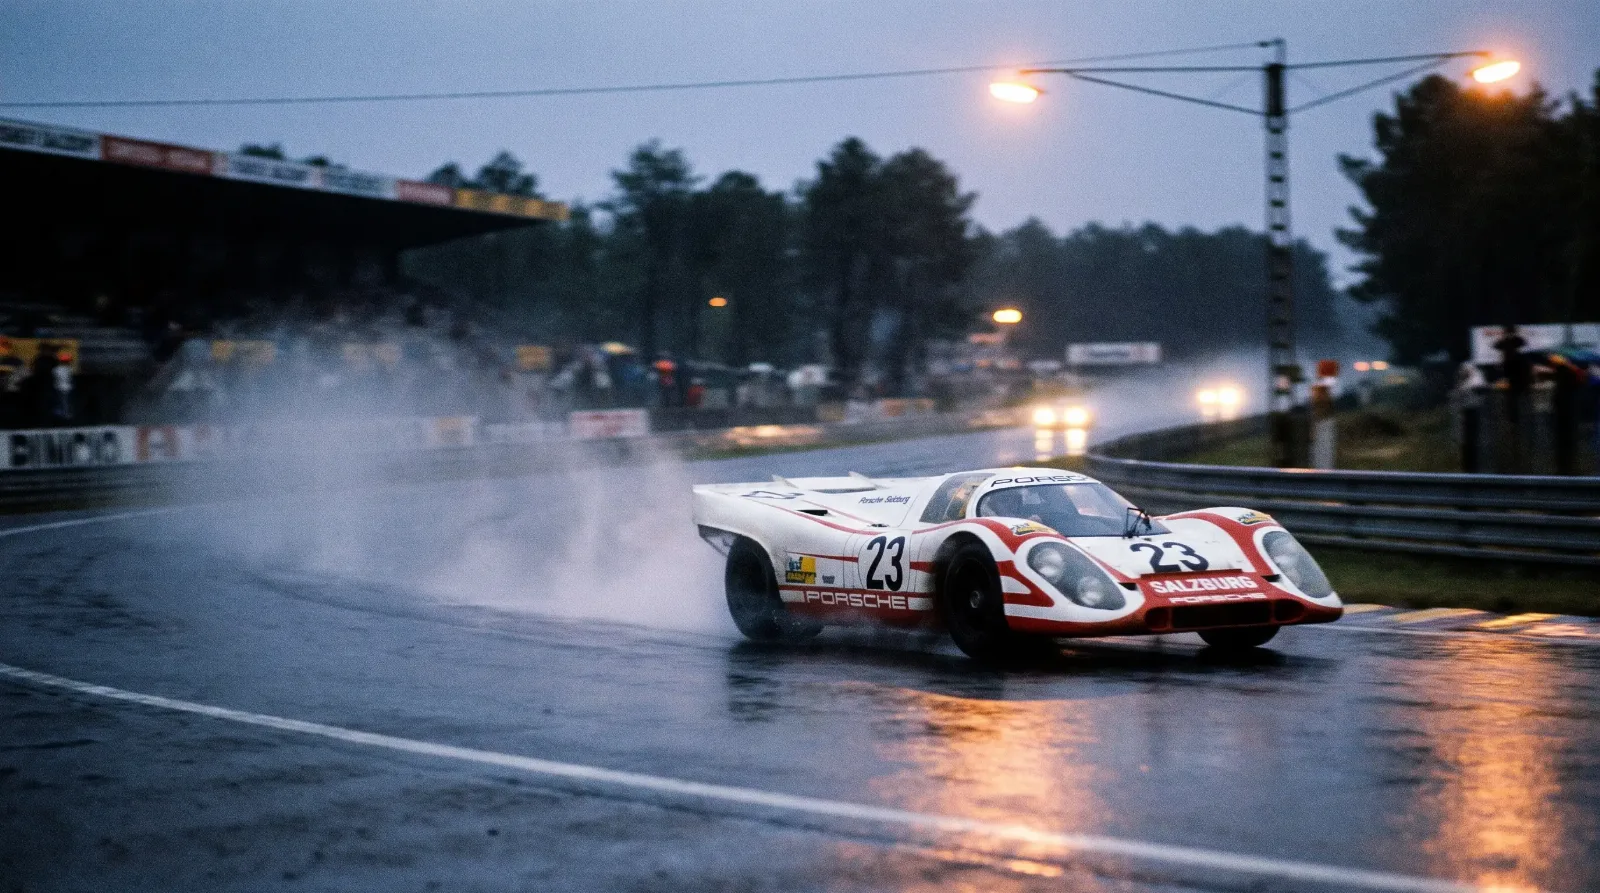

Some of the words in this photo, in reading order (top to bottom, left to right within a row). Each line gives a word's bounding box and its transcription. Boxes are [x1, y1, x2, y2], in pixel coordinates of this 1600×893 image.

[866, 535, 906, 591] 23
[1130, 541, 1209, 573] 23
[1150, 575, 1258, 594] SALZBURG
[806, 591, 906, 610] PORSCHE
